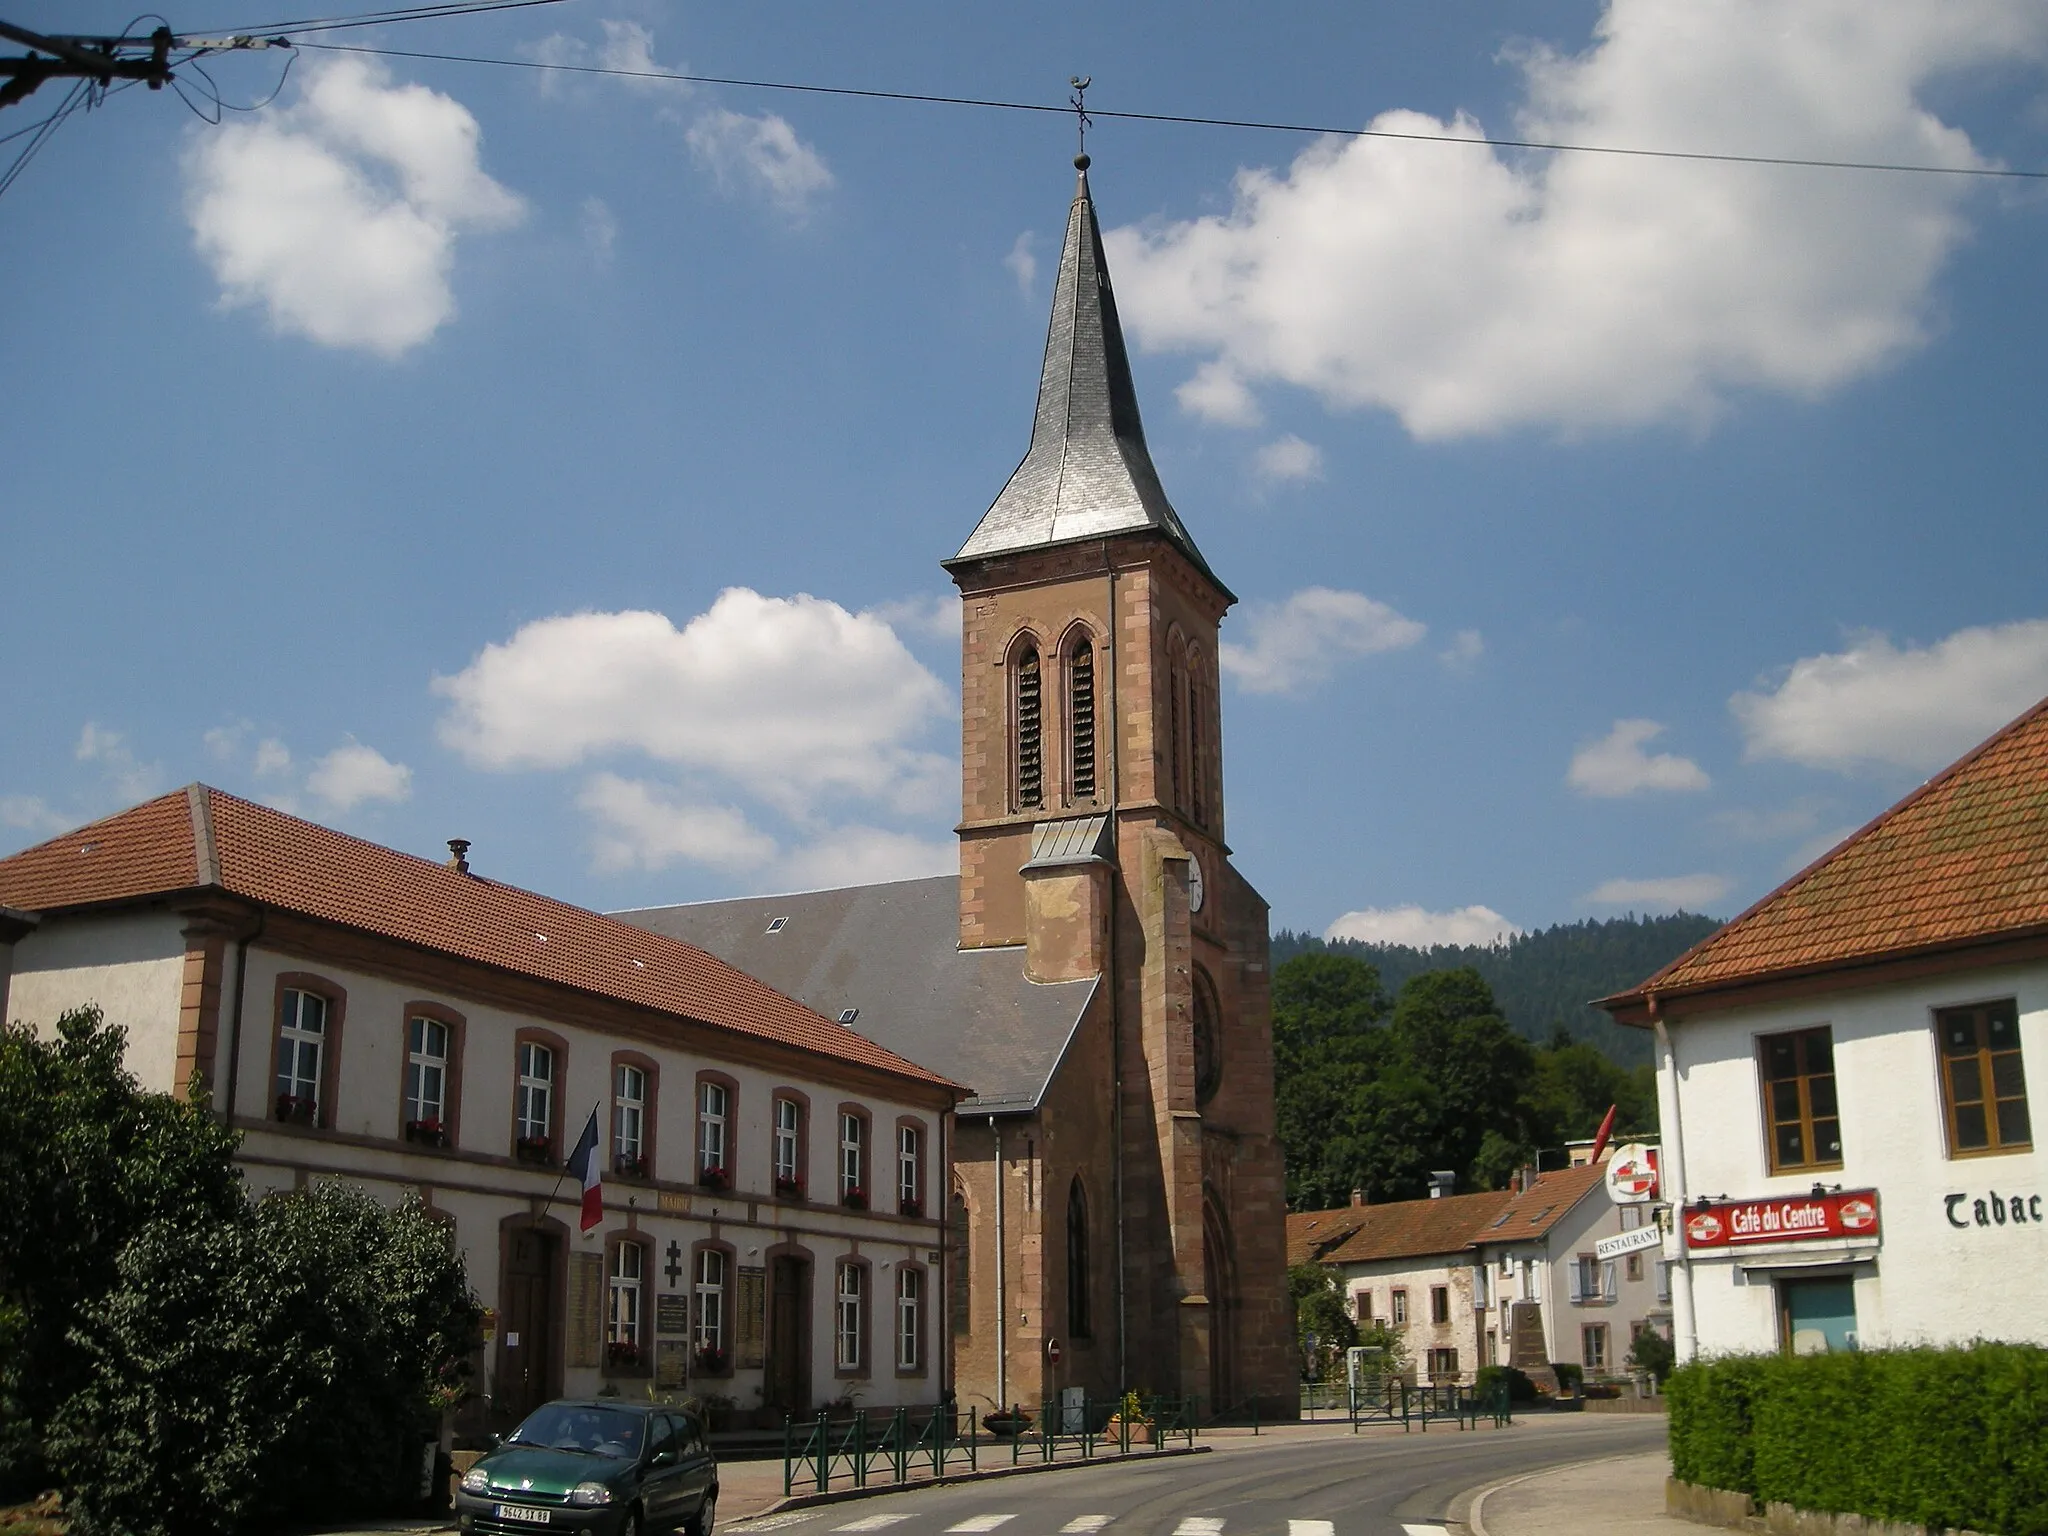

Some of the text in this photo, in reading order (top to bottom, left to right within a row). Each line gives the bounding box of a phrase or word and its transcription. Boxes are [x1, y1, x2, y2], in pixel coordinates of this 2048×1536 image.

[1731, 1205, 1761, 1234] Café
[1762, 1204, 1780, 1230] du
[1781, 1203, 1825, 1229] Centre
[1944, 1189, 2043, 1229] Tabac
[1598, 1229, 1658, 1255] RESTAURANT
[537, 1511, 548, 1522] 88
